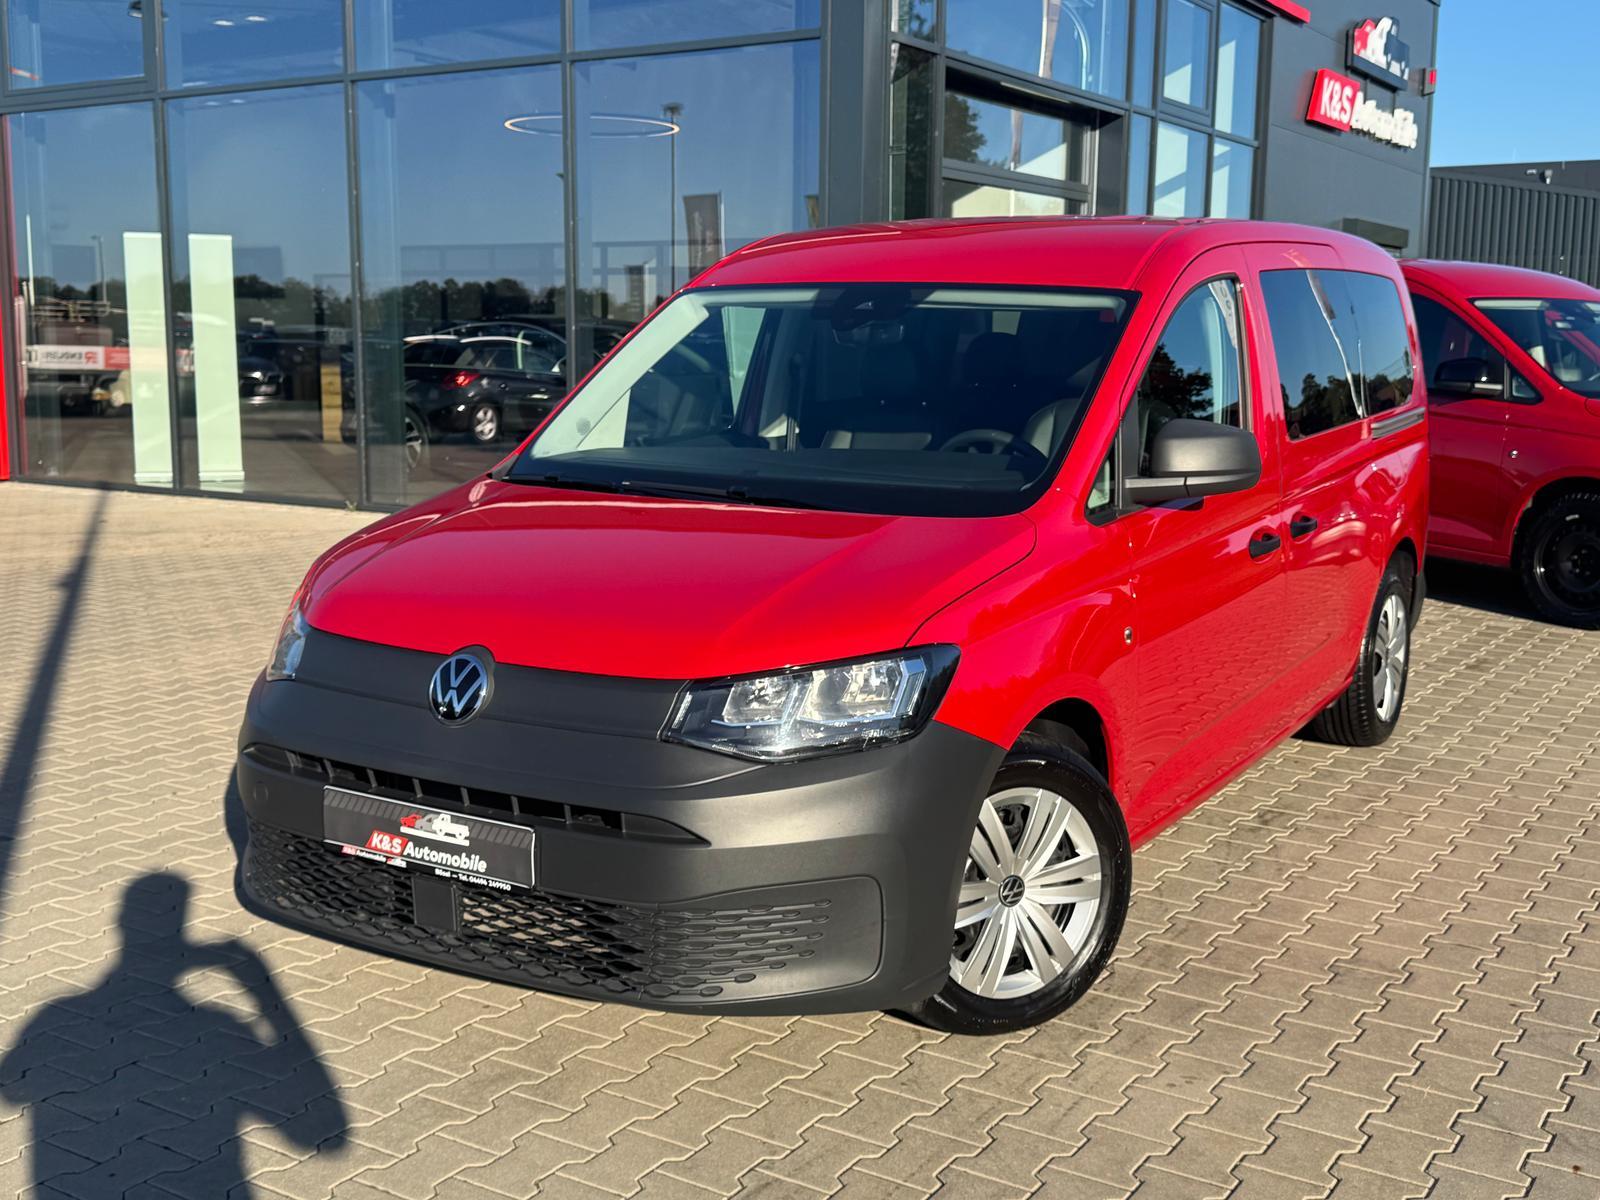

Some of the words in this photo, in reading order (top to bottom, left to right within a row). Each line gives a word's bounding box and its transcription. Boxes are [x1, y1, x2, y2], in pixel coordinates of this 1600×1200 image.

[1320, 76, 1354, 124] K&S
[370, 832, 402, 854] K&S
[403, 841, 487, 873] Automobile
